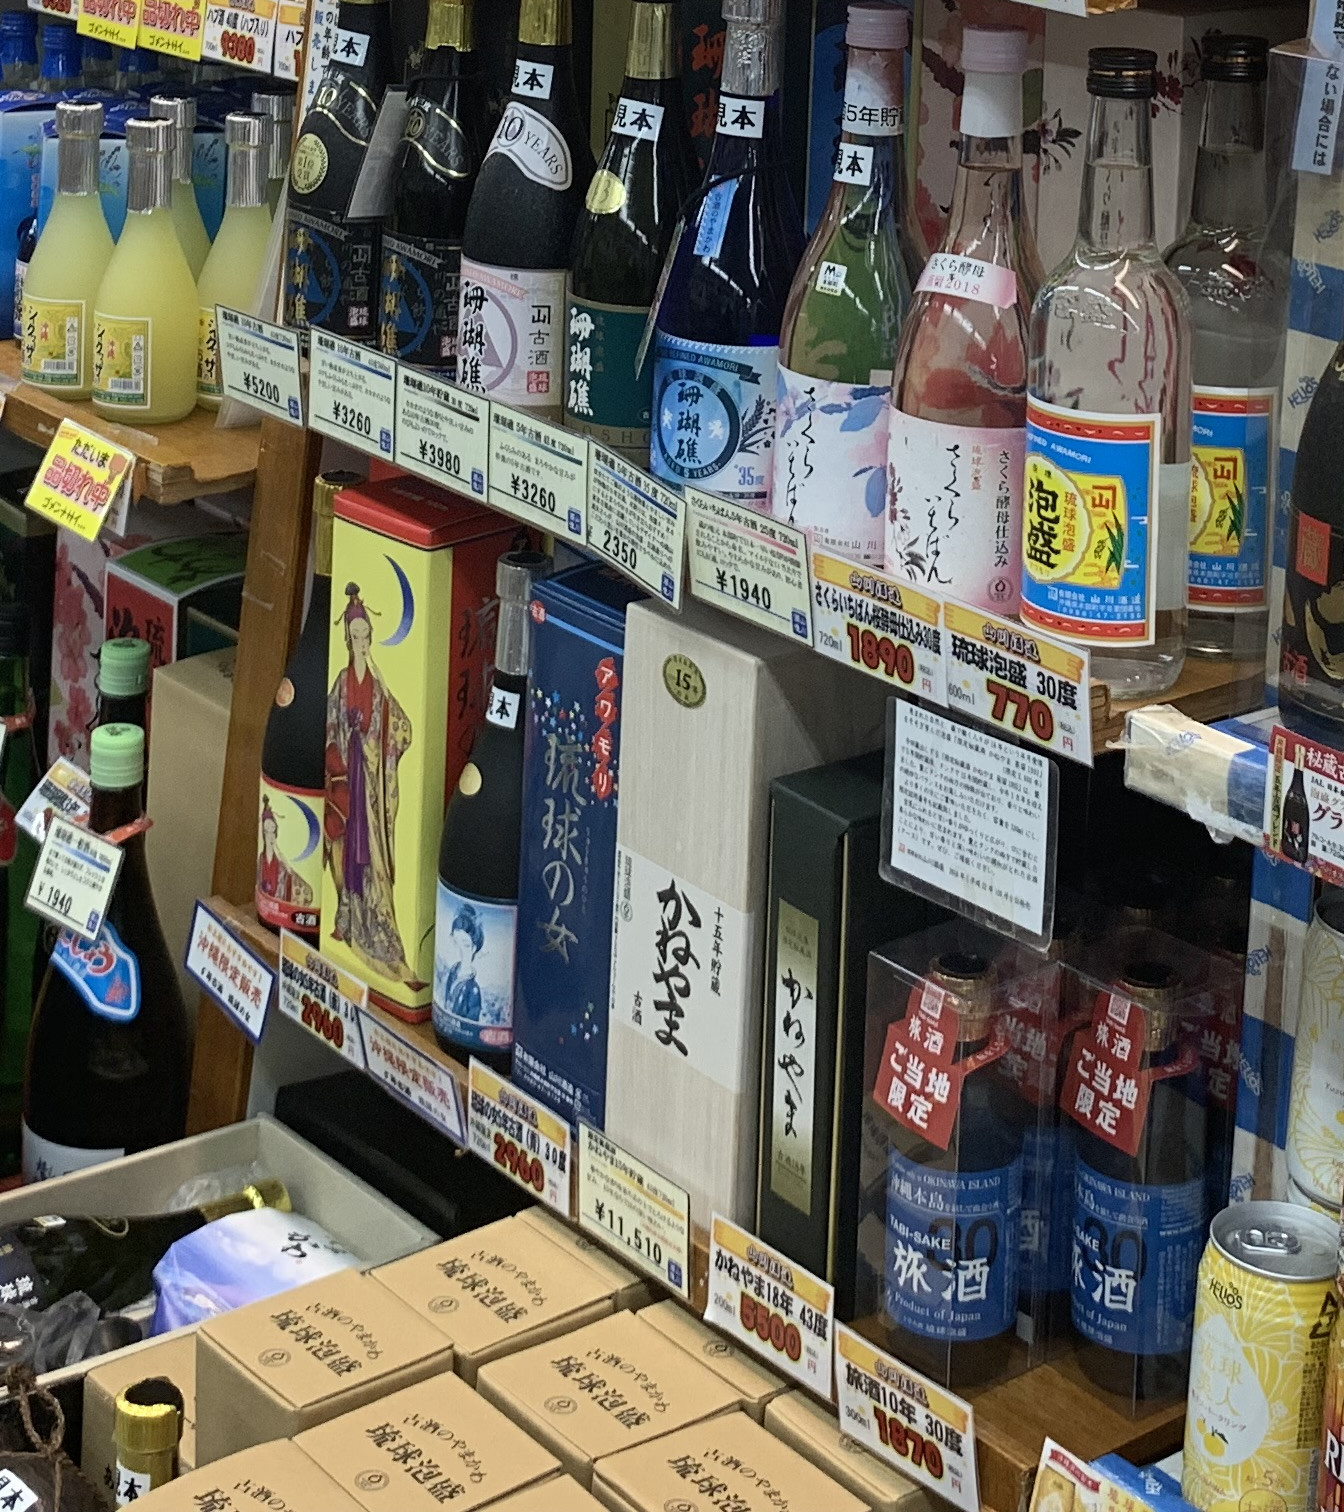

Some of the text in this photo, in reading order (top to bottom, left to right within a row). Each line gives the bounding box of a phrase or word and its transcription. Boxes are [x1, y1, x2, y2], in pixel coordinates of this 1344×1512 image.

[522, 131, 565, 176] YEARS
[715, 566, 773, 612] ¥1940
[846, 622, 916, 685] 1890
[986, 680, 1055, 742] 770
[653, 879, 702, 1057] かねやま
[886, 1040, 951, 1105] ご当地
[886, 1083, 930, 1132] 限定
